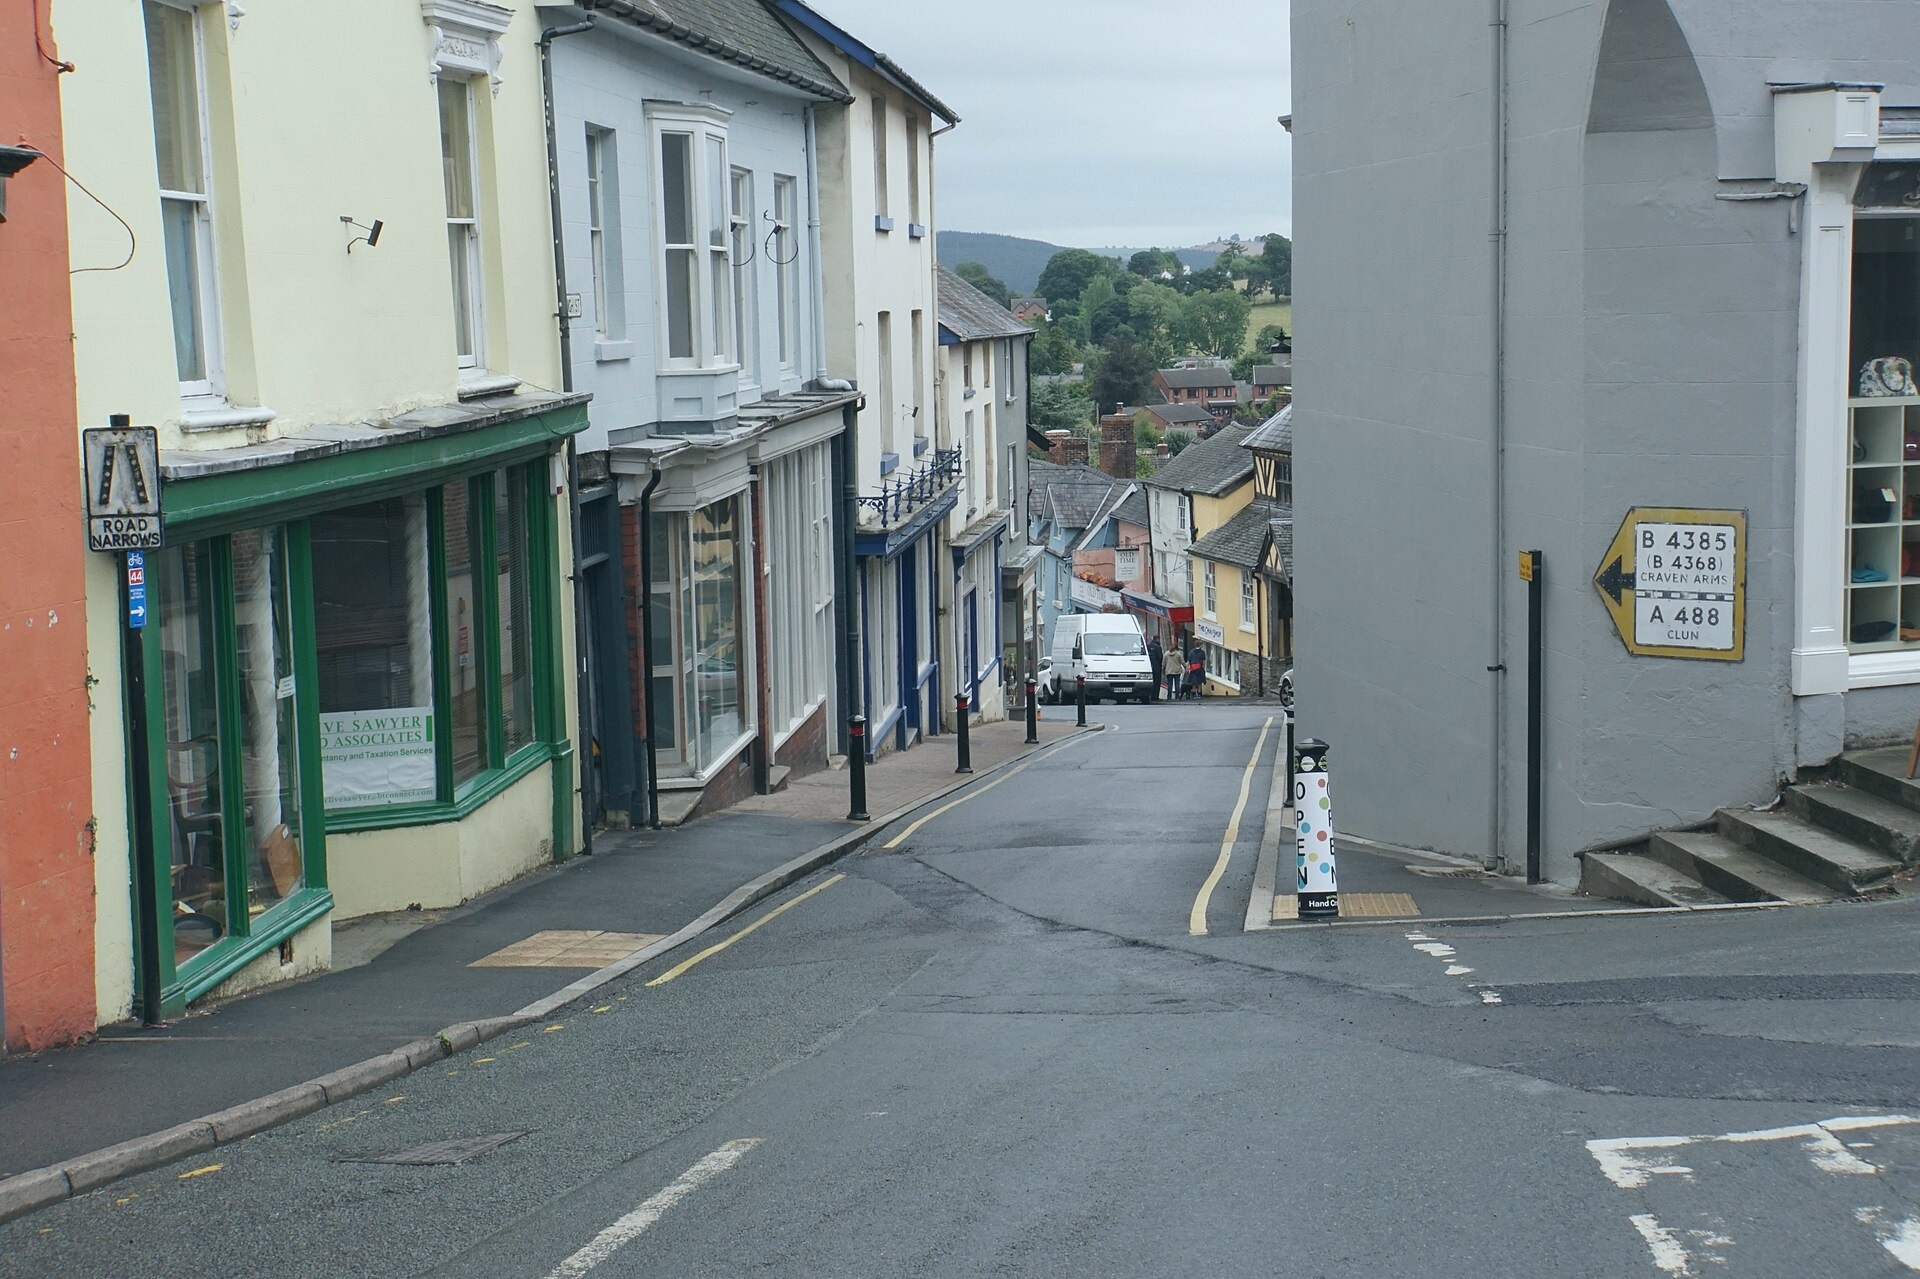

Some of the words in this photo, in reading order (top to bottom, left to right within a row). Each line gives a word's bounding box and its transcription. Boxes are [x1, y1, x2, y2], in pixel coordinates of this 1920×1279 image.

[103, 518, 148, 533] ROAD
[92, 532, 160, 548] NARROWS
[1642, 530, 1655, 548] B
[1665, 531, 1727, 551] 4385
[1647, 554, 1663, 569] (B
[1671, 555, 1723, 571] 4368)
[131, 571, 143, 582] 44
[1640, 572, 1689, 583] CRAVEN
[1693, 574, 1728, 585] ARMS
[1649, 605, 1664, 623] A
[1674, 606, 1720, 626] 488
[1667, 629, 1700, 640] CLUN
[319, 721, 344, 734] VE
[352, 715, 421, 732] SAWYER
[334, 730, 422, 748] ASSOCIATES
[349, 752, 364, 760] and
[365, 748, 399, 759] Taxation
[400, 746, 433, 756] Services
[1308, 900, 1330, 908] Hand
